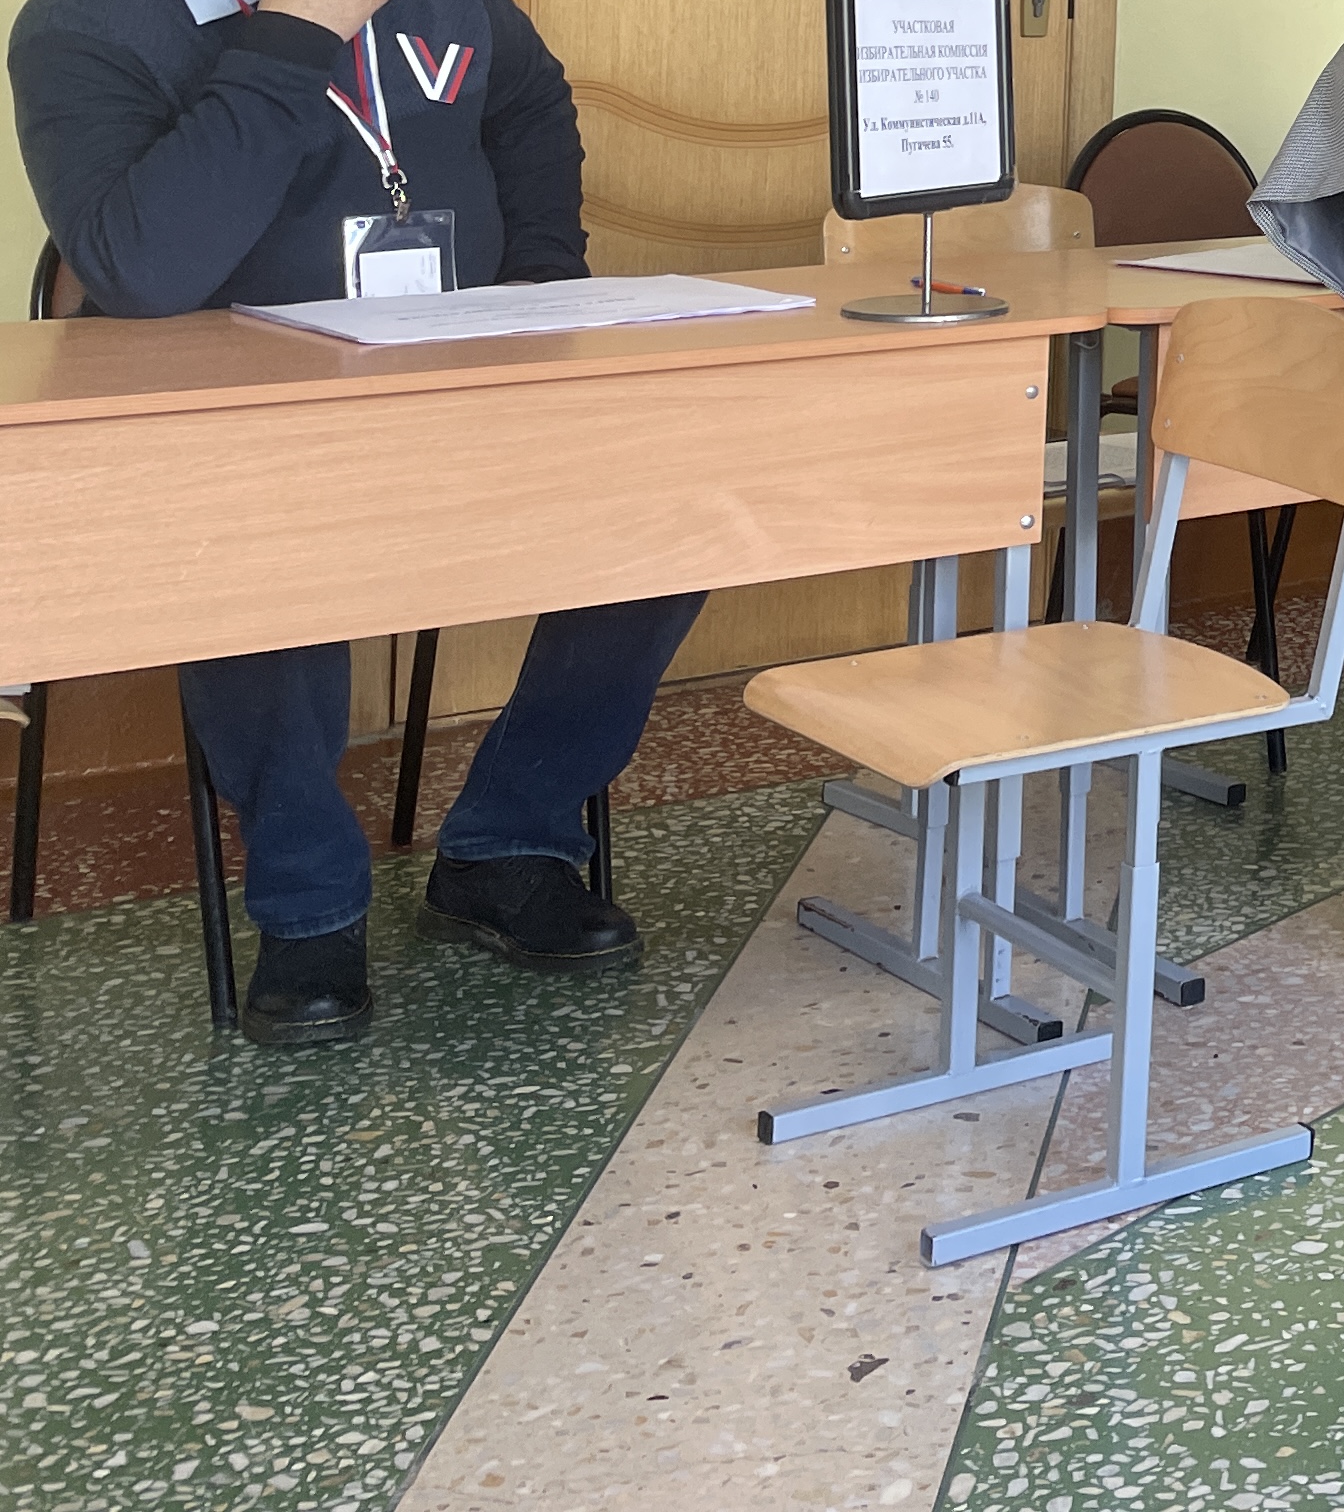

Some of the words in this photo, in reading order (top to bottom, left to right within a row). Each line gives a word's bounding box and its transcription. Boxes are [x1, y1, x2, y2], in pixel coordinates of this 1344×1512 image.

[892, 19, 955, 34] УЧАСТКОВАЯ
[857, 45, 936, 60] ИЗБИРАТЕЛЬНАЯ
[937, 43, 988, 58] КОМИССИЯ
[859, 67, 944, 83] ИЗБИРАТЕЛЬНОГО
[946, 66, 987, 81] УЧАСТКА
[881, 116, 961, 133] Коммунистическая
[901, 138, 941, 155] Пугачева
